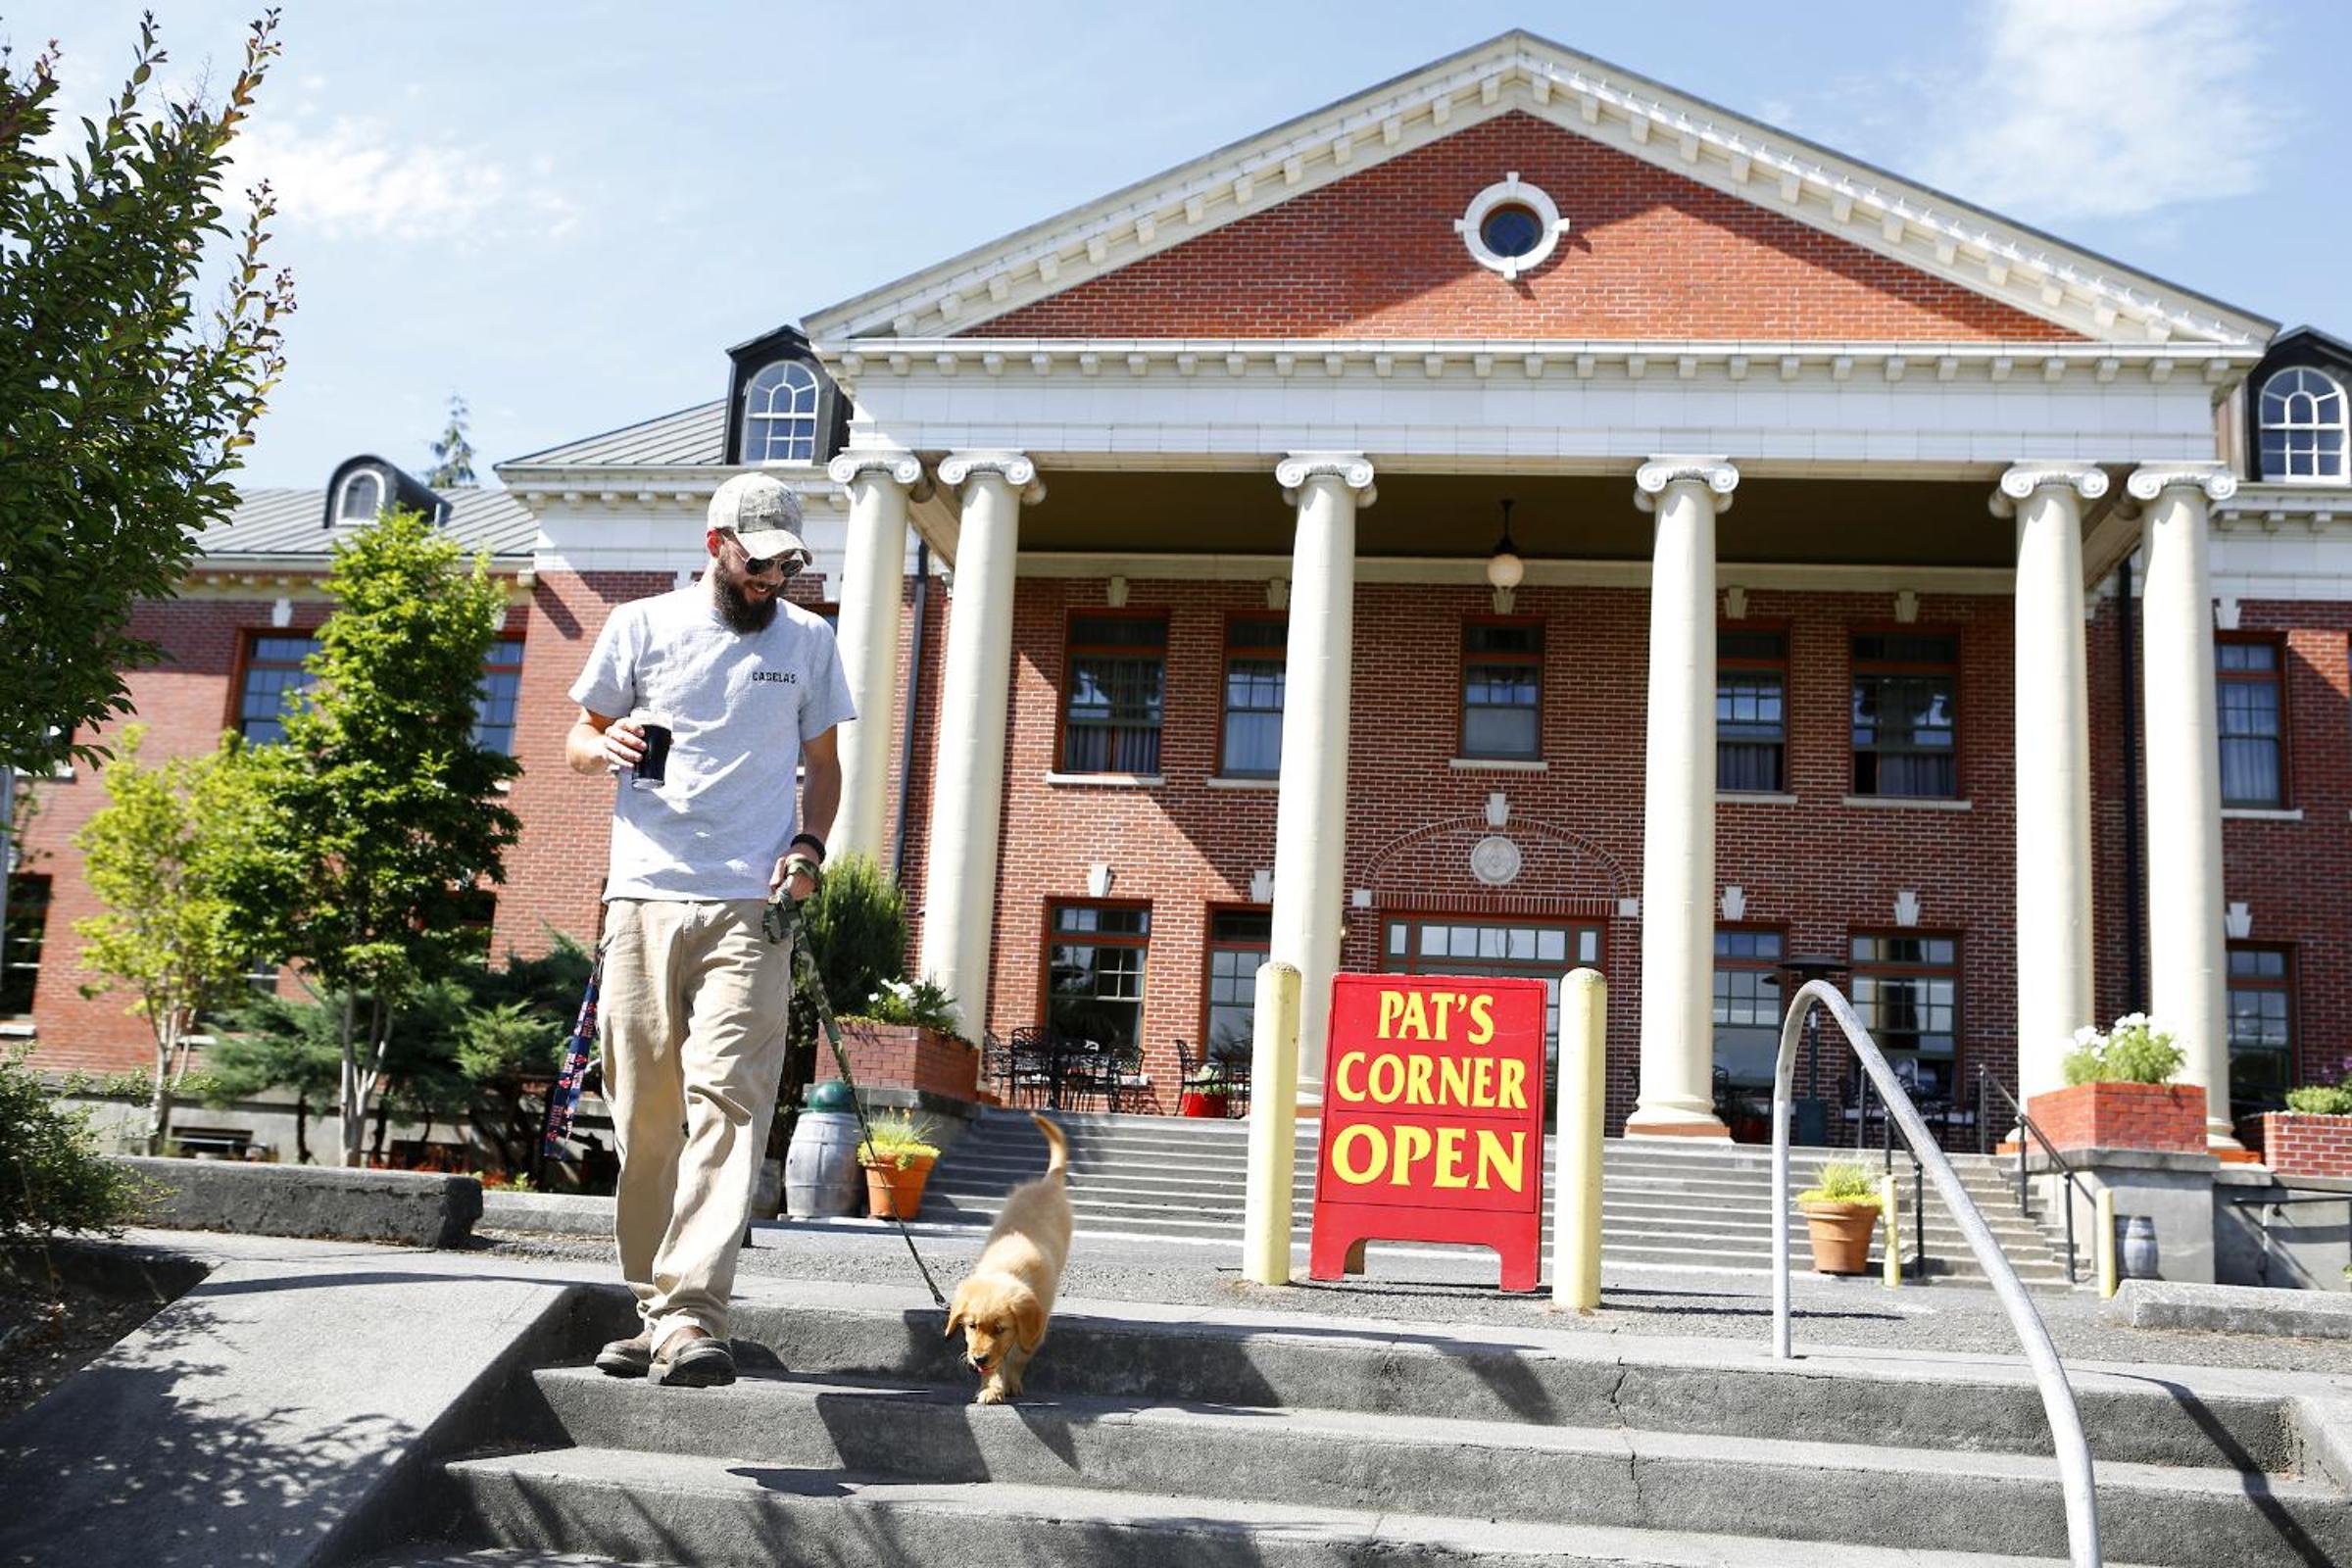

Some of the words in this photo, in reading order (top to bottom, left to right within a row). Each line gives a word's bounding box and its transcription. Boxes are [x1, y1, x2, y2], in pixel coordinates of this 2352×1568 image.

[1376, 990, 1494, 1045] PAT'S
[1336, 1051, 1528, 1109] CORNER
[1331, 1124, 1526, 1192] OPEN
